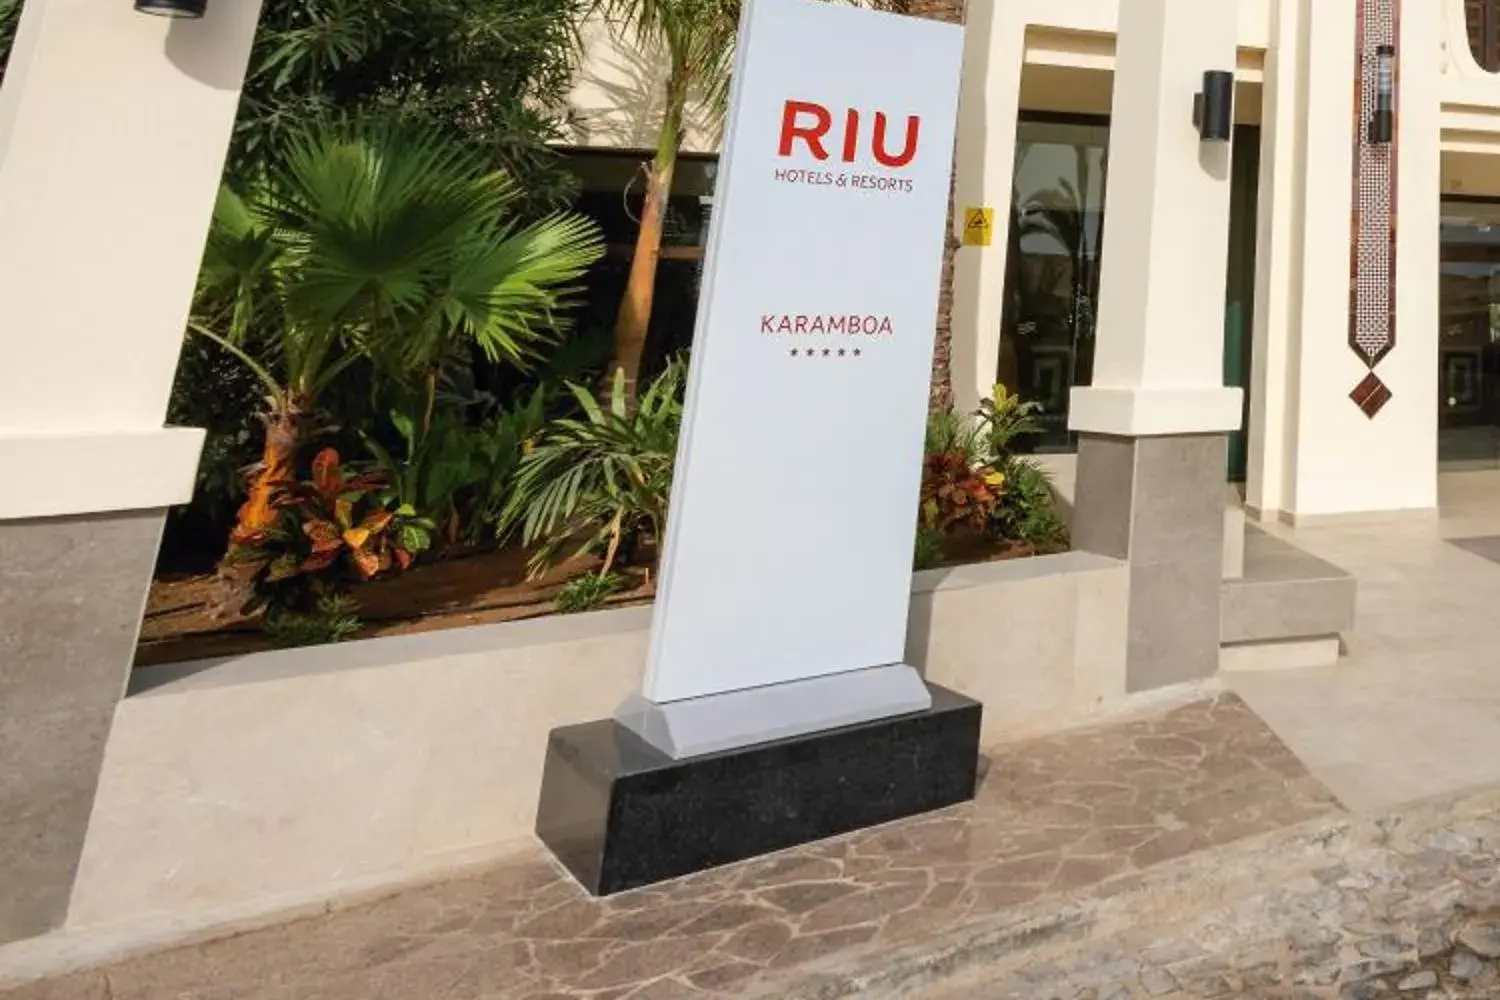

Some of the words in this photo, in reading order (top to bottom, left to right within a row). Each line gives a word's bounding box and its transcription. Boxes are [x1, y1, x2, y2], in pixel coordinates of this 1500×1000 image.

[778, 99, 920, 168] RIU
[774, 168, 833, 186] HOTELS
[836, 173, 848, 187] &
[851, 174, 914, 193] RESORTS
[760, 314, 893, 336] KARAMBOA
